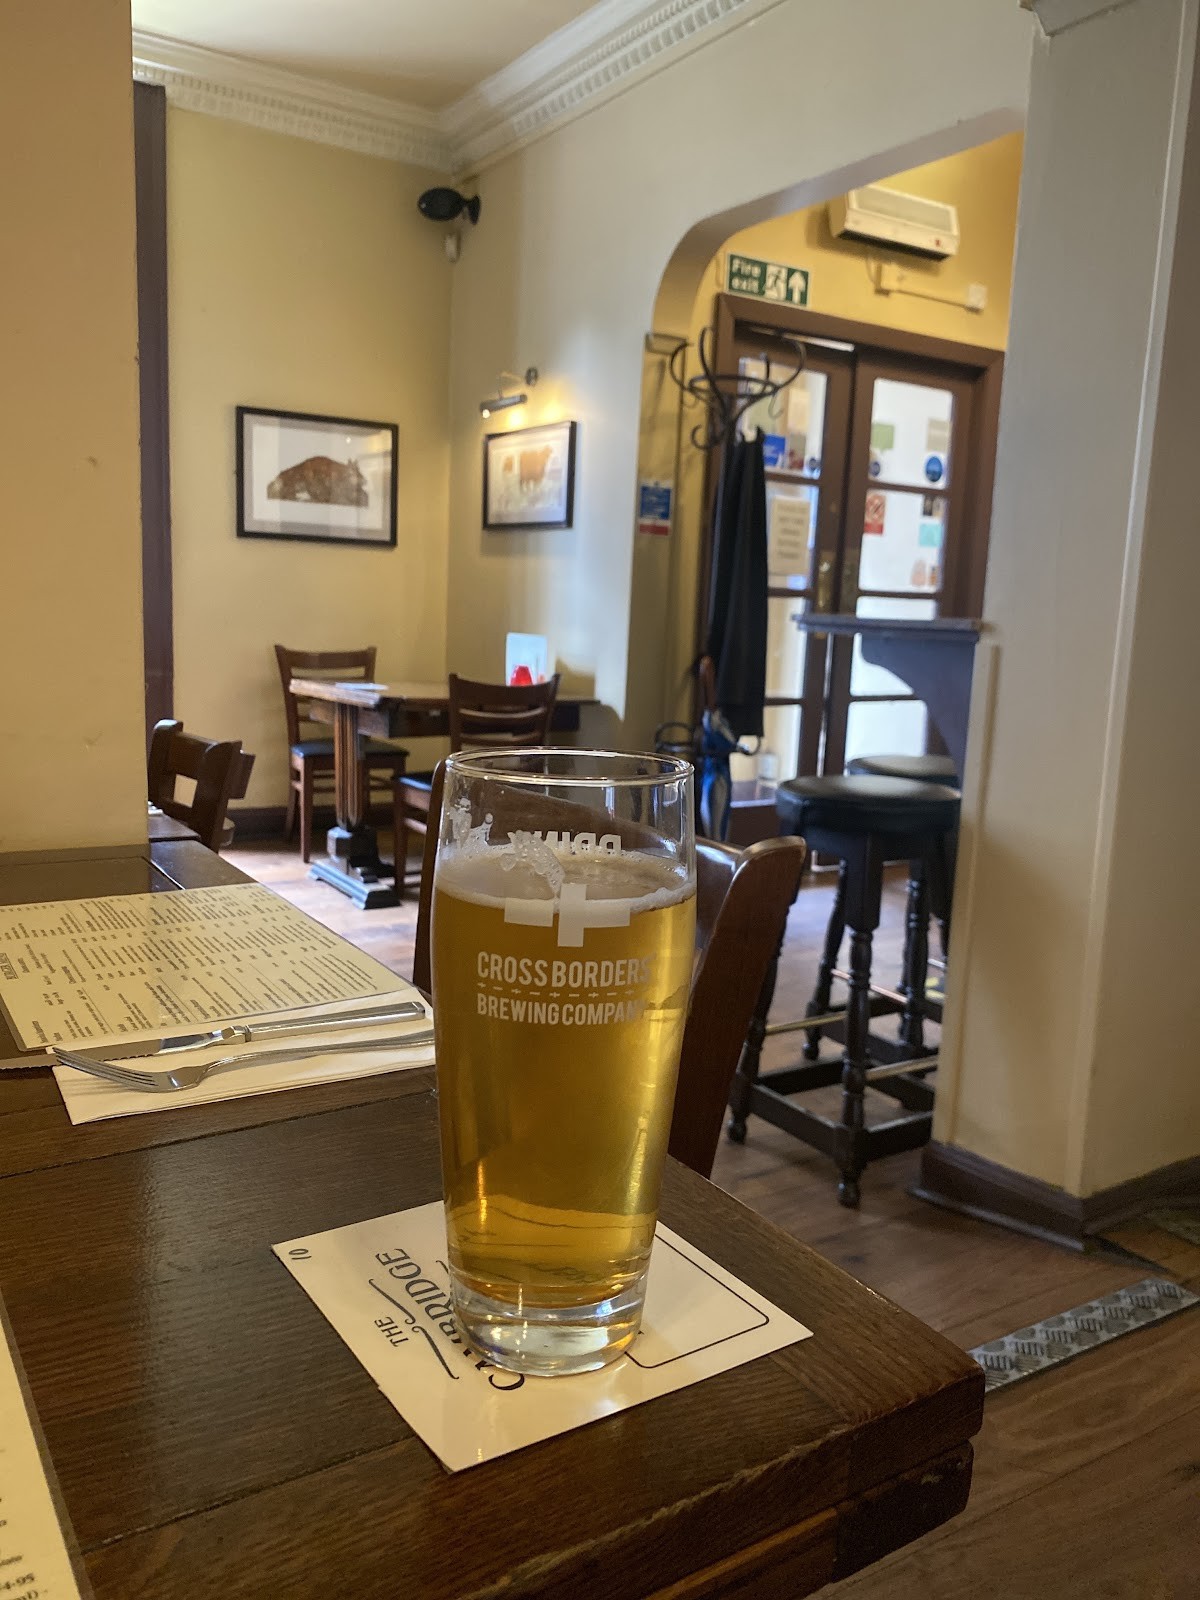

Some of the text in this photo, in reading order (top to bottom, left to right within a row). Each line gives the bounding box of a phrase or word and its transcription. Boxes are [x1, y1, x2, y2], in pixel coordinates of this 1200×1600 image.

[732, 258, 761, 278] Fire
[731, 276, 759, 294] exit
[477, 951, 651, 988] CROSS BORDERS
[477, 993, 645, 1026] BREWING COMPAN
[374, 1316, 409, 1347] THE
